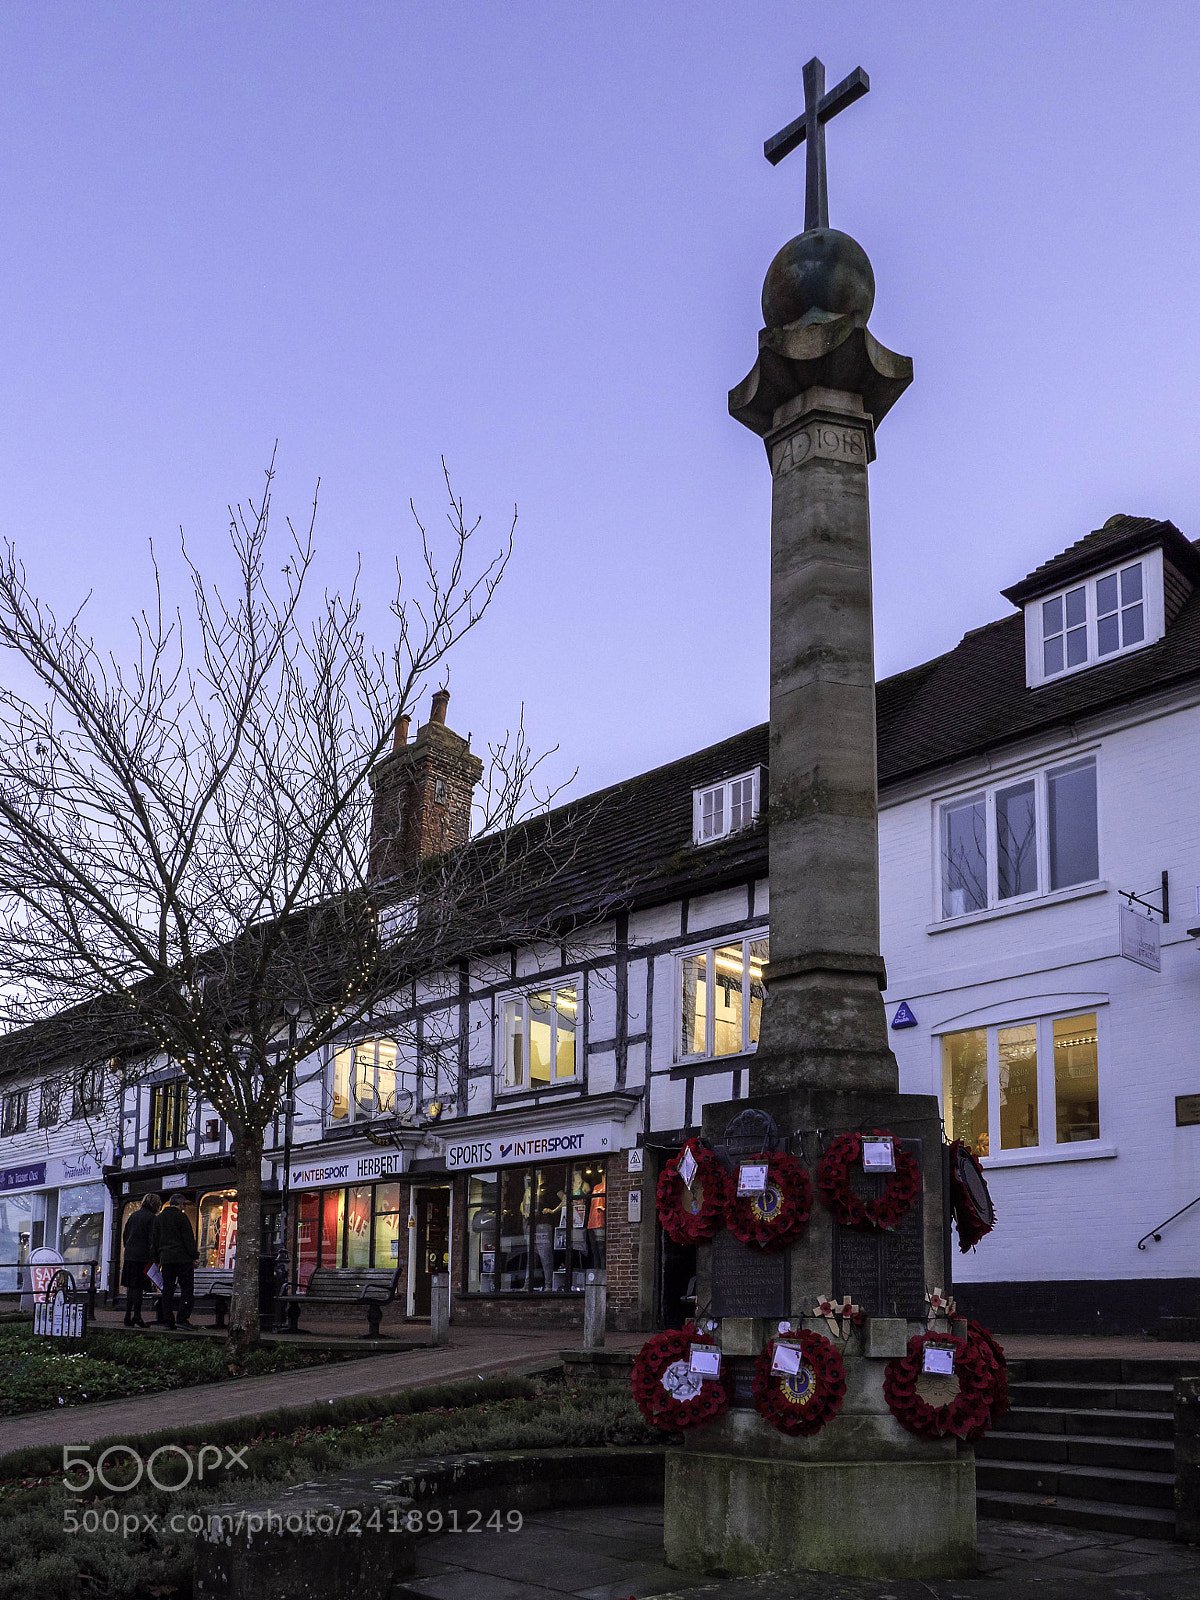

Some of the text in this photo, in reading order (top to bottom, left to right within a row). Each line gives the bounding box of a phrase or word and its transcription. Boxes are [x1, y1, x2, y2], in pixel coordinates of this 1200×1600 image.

[816, 428, 863, 455] 1918
[449, 1133, 585, 1166] SPORTS INTERSPORT
[301, 1154, 400, 1182] INTERSPORT HERBERT
